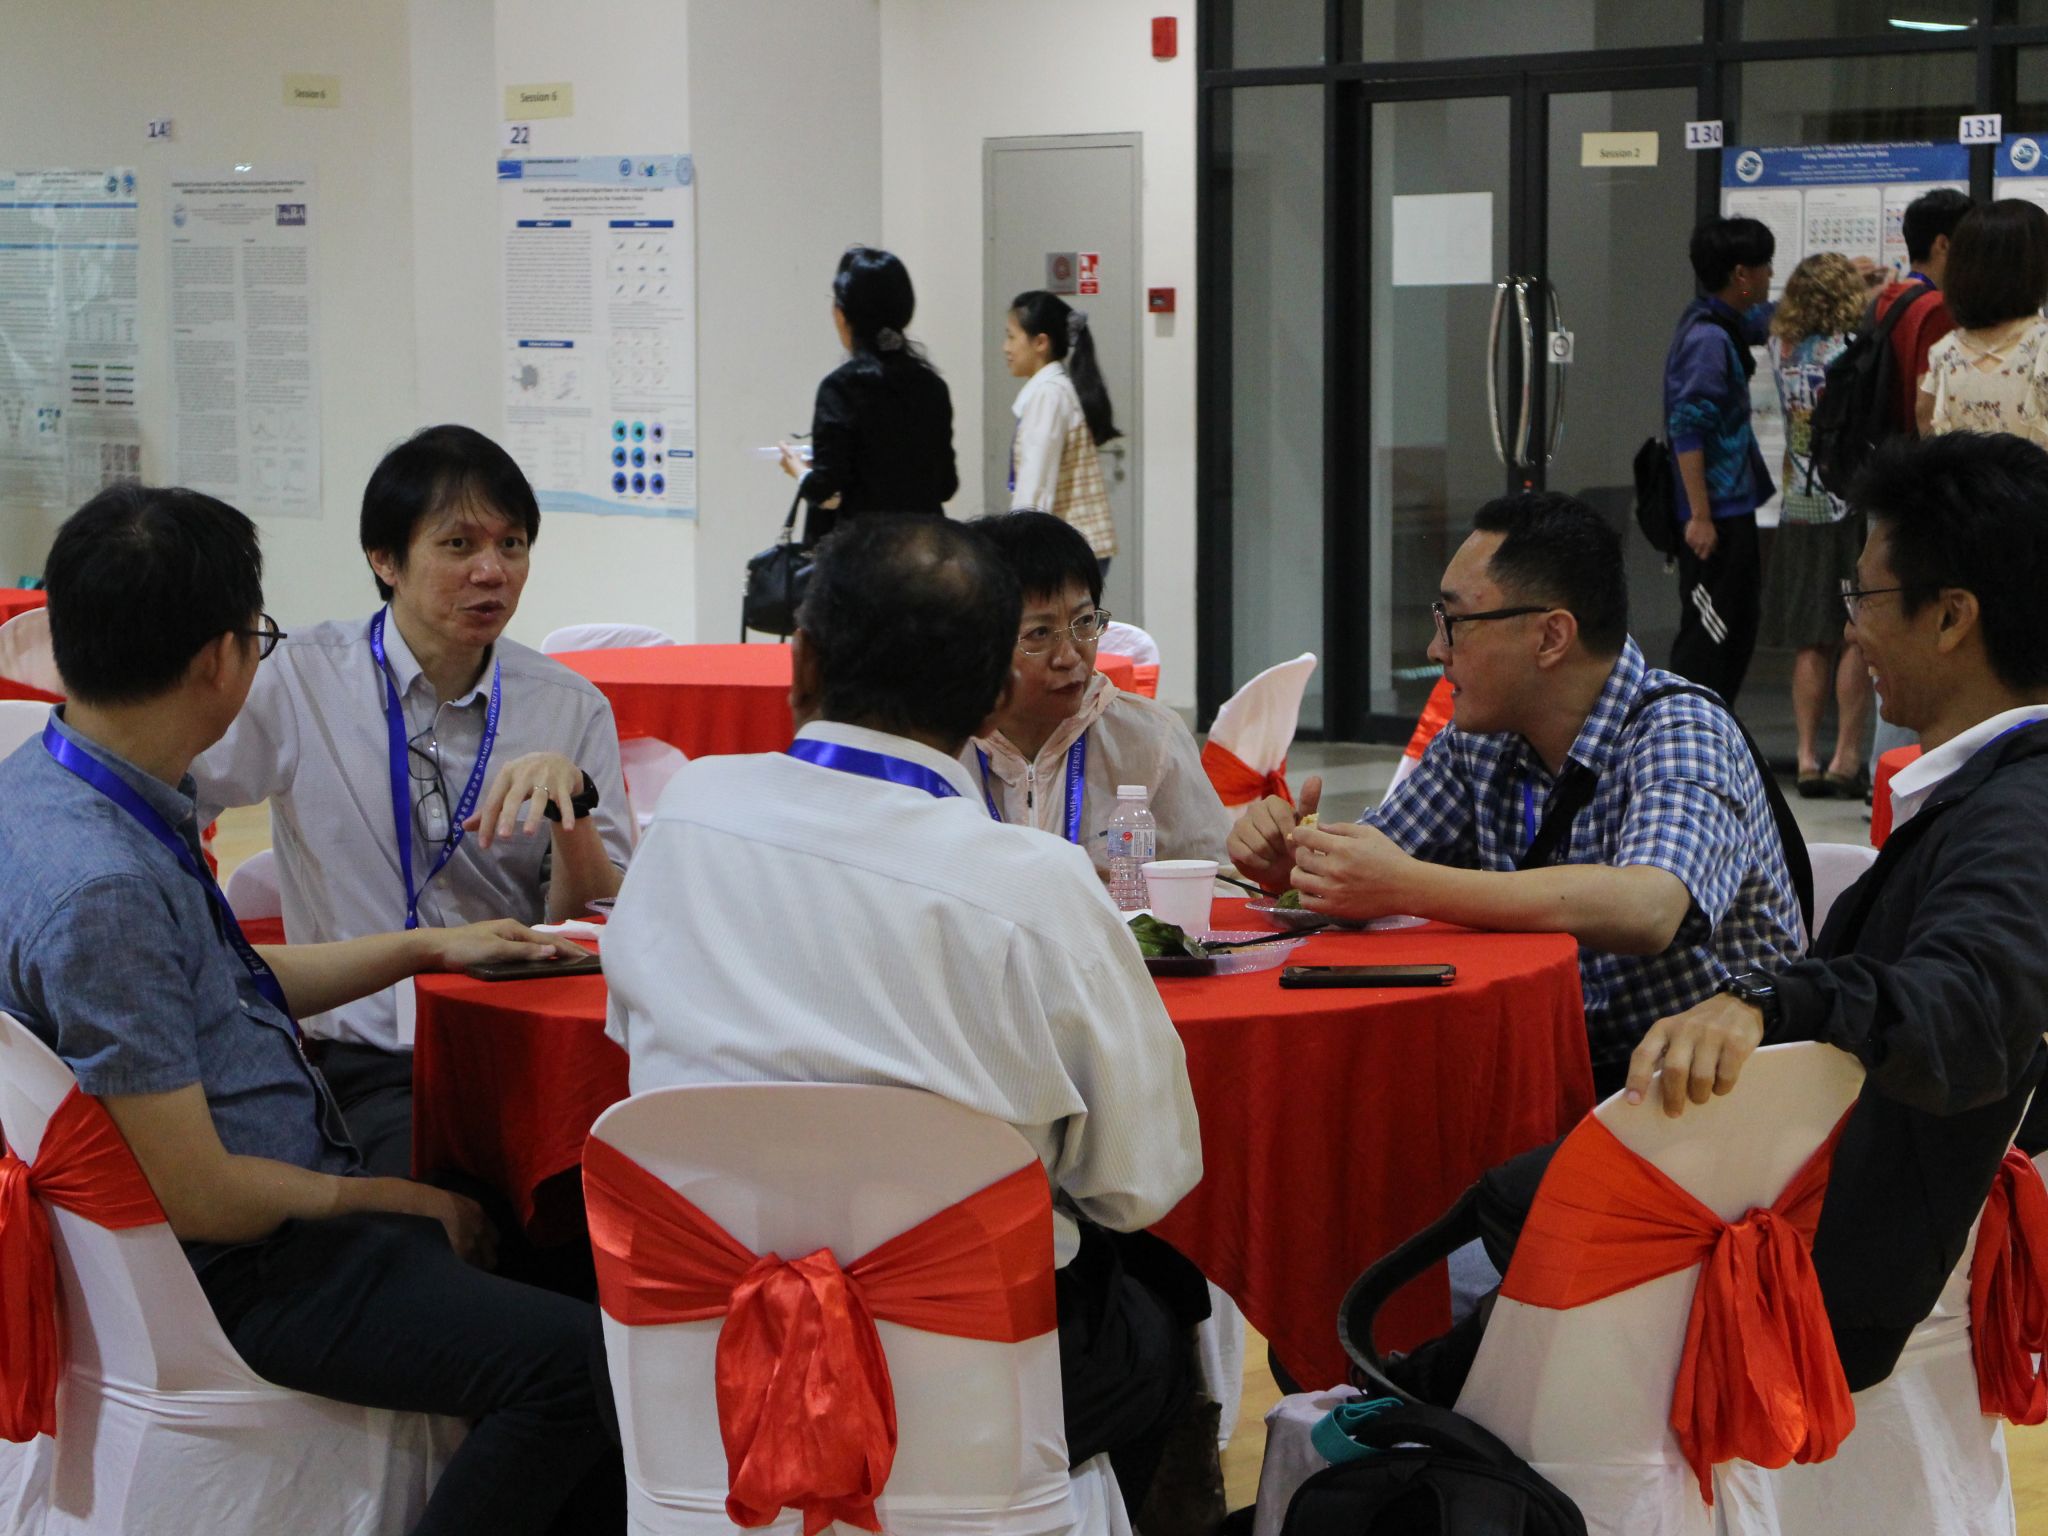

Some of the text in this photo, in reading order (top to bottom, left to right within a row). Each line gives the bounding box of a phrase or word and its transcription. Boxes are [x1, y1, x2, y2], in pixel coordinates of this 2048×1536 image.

[520, 90, 558, 103] Session 6
[510, 126, 529, 145] 22
[1690, 124, 1722, 144] 130
[1964, 119, 1998, 138] 131
[1600, 147, 1641, 160] Session 2
[477, 737, 491, 771] XIAMEN
[487, 686, 500, 734] UNIVERSITY
[1071, 741, 1082, 790] UNIVERSITY
